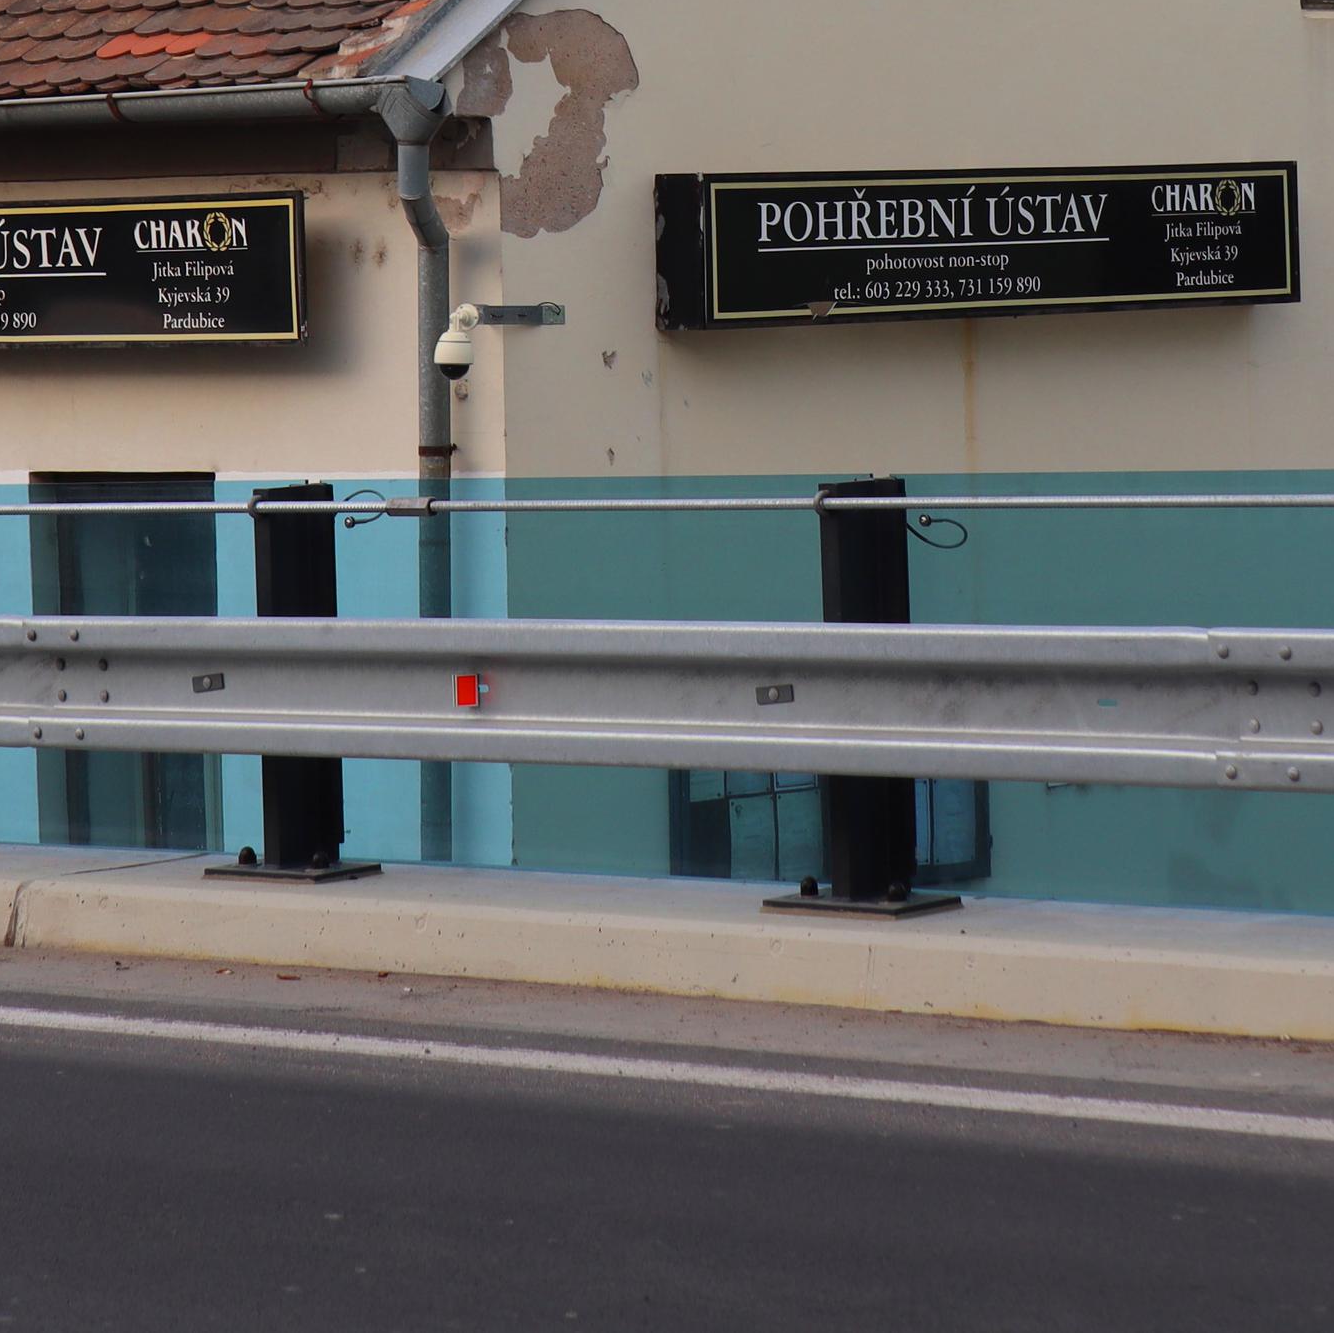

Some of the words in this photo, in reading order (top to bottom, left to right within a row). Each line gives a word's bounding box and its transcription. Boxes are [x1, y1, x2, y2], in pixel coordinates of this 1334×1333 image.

[757, 186, 976, 242] POHŘEBNÍ
[986, 185, 1108, 237] ÚSTAV
[1164, 222, 1193, 242] Jitka
[1196, 219, 1242, 240] Filipová
[866, 253, 945, 276] pohotovost
[948, 254, 1010, 271] non-stop
[1170, 245, 1222, 267] Kyjevská
[1224, 245, 1238, 261] 39
[151, 261, 182, 282] Jitka
[184, 260, 235, 281] Filipová
[1176, 269, 1235, 286] Pardubice
[157, 286, 212, 308] Kyjevská
[214, 286, 230, 304] 39
[833, 283, 861, 301] tel.:
[865, 281, 890, 300] 603
[895, 280, 921, 299] 229
[925, 278, 956, 298] 333,
[958, 278, 982, 297] 731
[988, 277, 1013, 295] 159
[1016, 276, 1041, 294] 890
[12, 312, 37, 330] 890
[162, 312, 225, 330] Pardubice
